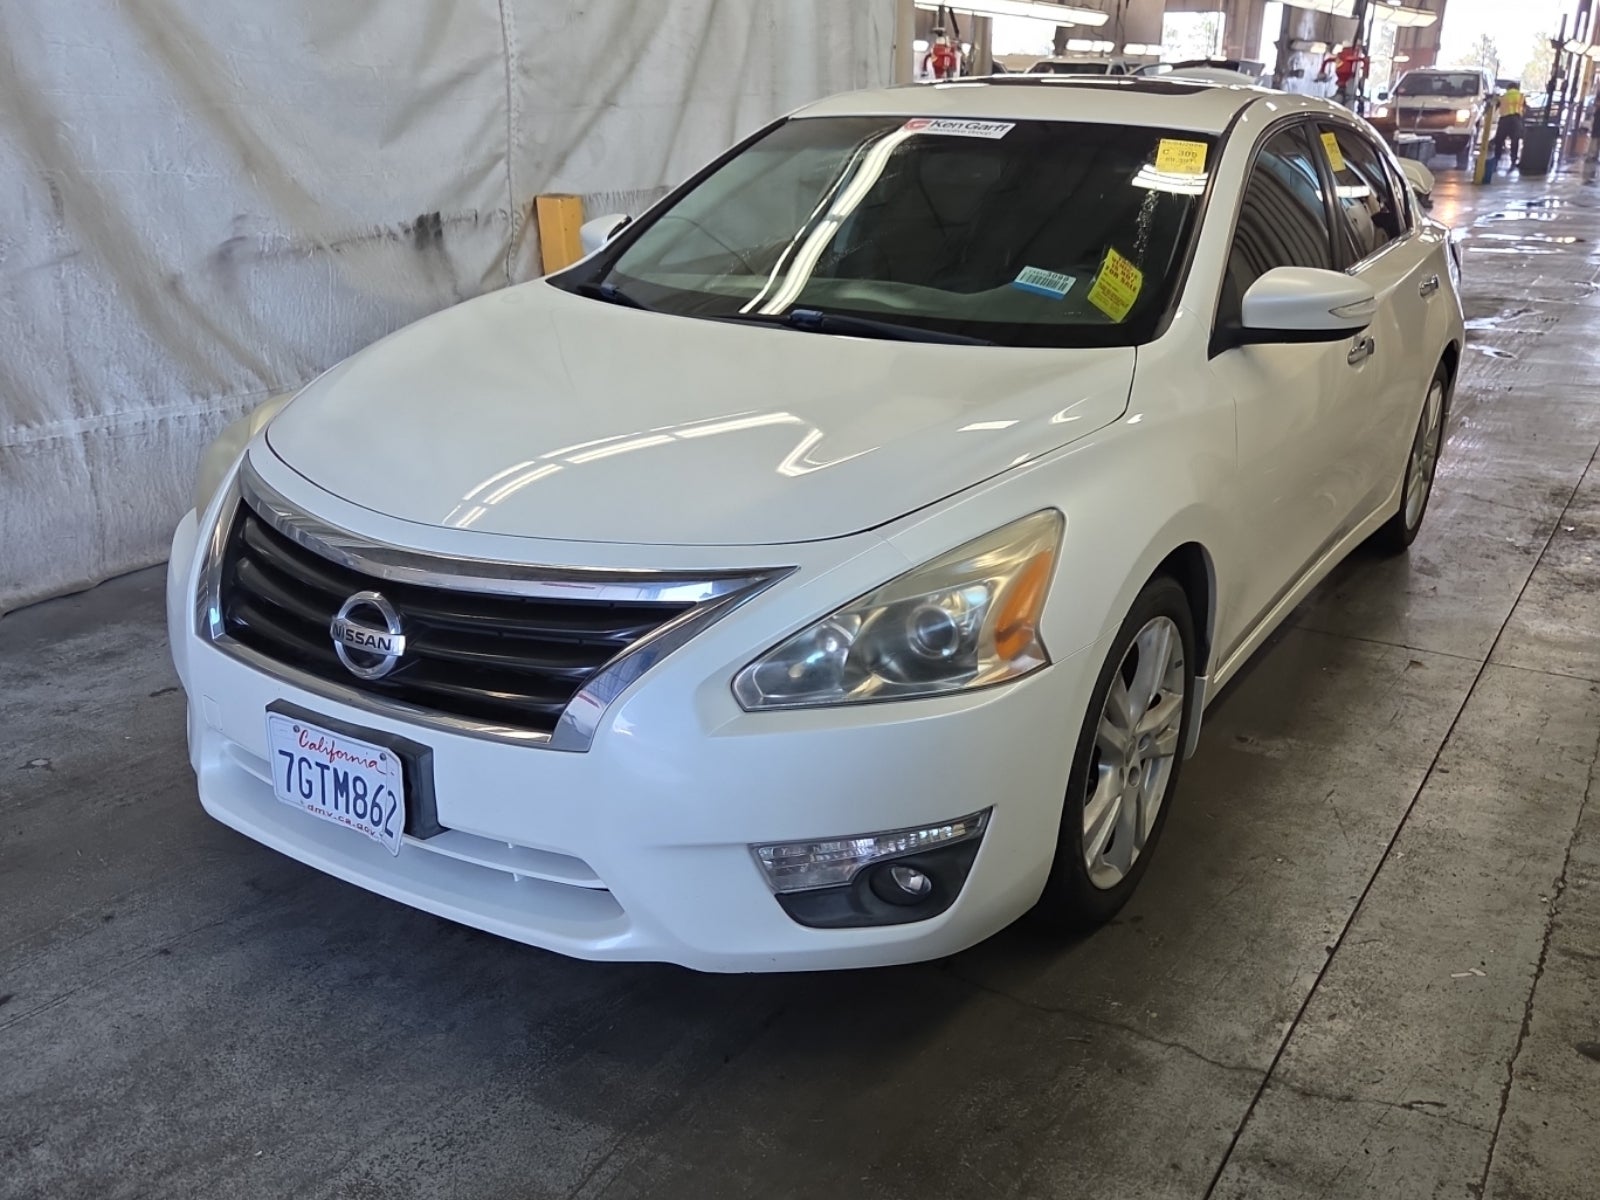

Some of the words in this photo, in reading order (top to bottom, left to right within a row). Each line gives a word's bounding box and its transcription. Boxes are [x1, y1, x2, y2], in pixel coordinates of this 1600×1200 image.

[930, 120, 964, 129] Ken
[965, 122, 1009, 132] Garff
[333, 622, 392, 651] NISSAN
[298, 728, 387, 775] California
[278, 750, 398, 839] 7GTM862
[307, 804, 376, 837] dmv.ca.gov
